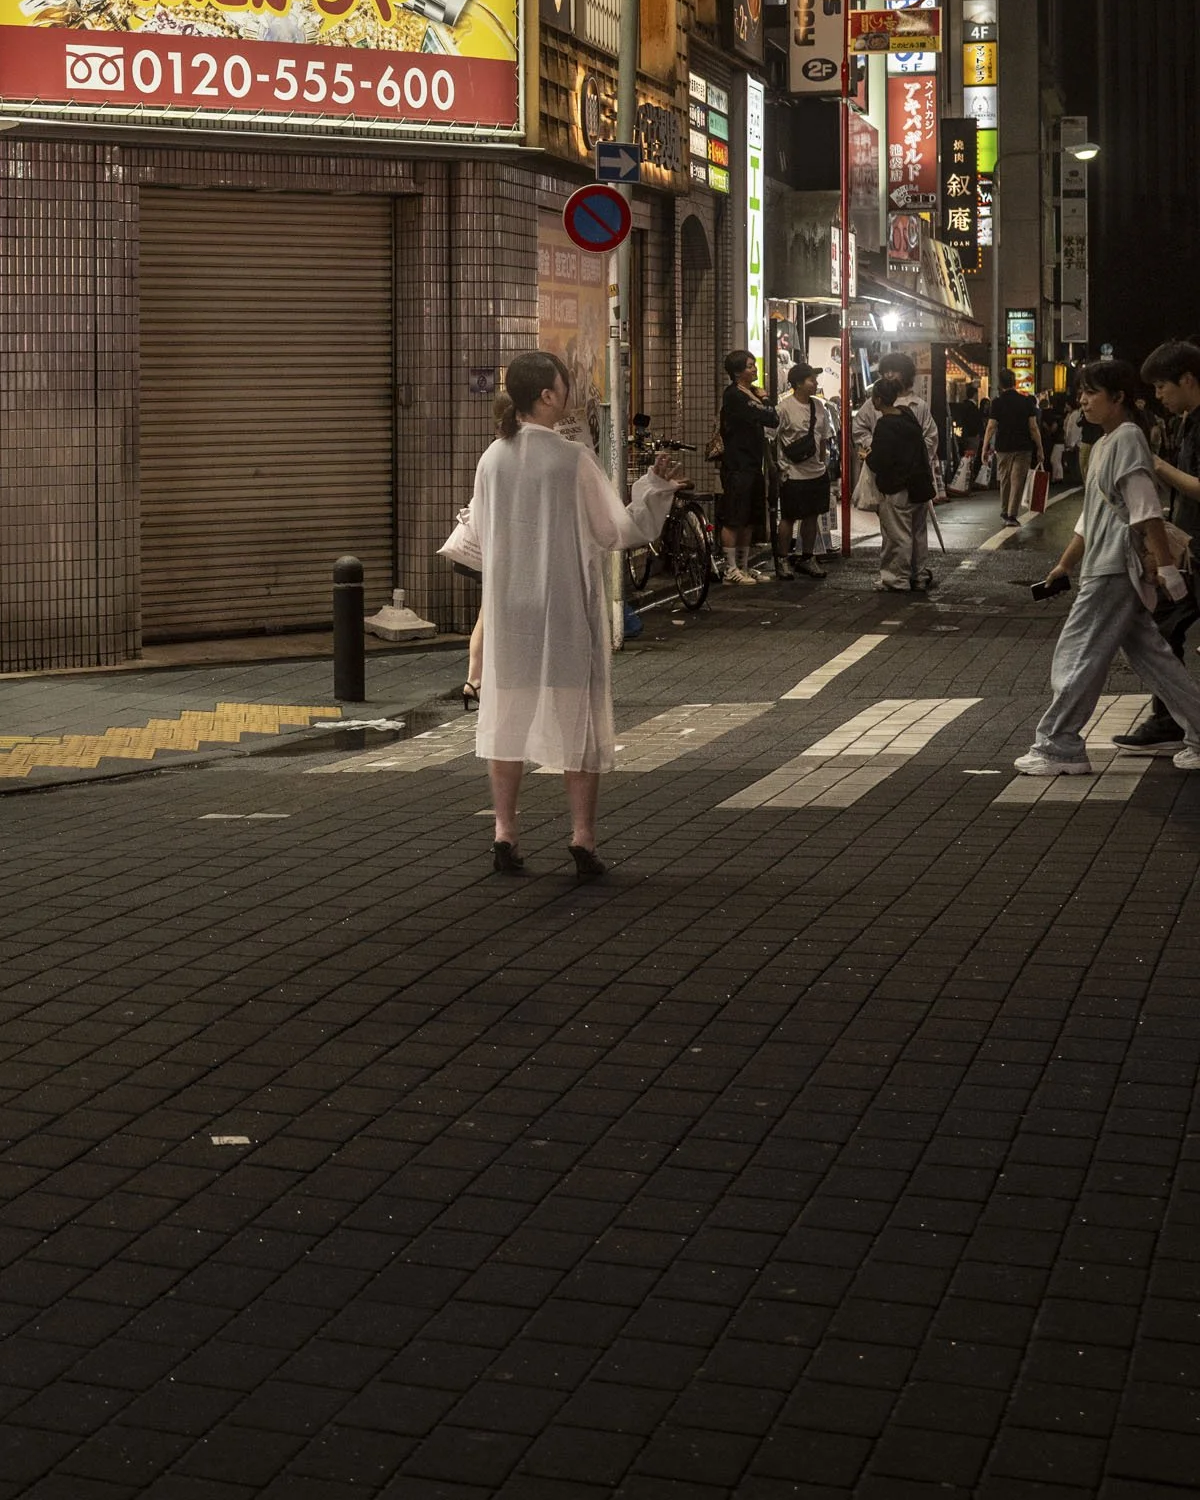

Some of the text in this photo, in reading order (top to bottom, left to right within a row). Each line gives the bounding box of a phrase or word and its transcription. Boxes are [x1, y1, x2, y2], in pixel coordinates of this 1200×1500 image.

[970, 26, 989, 39] 4F
[132, 49, 455, 112] 0120-555-600
[808, 61, 833, 78] 2F
[903, 82, 923, 182] アキバギルド
[924, 80, 935, 140] メイドカジノ
